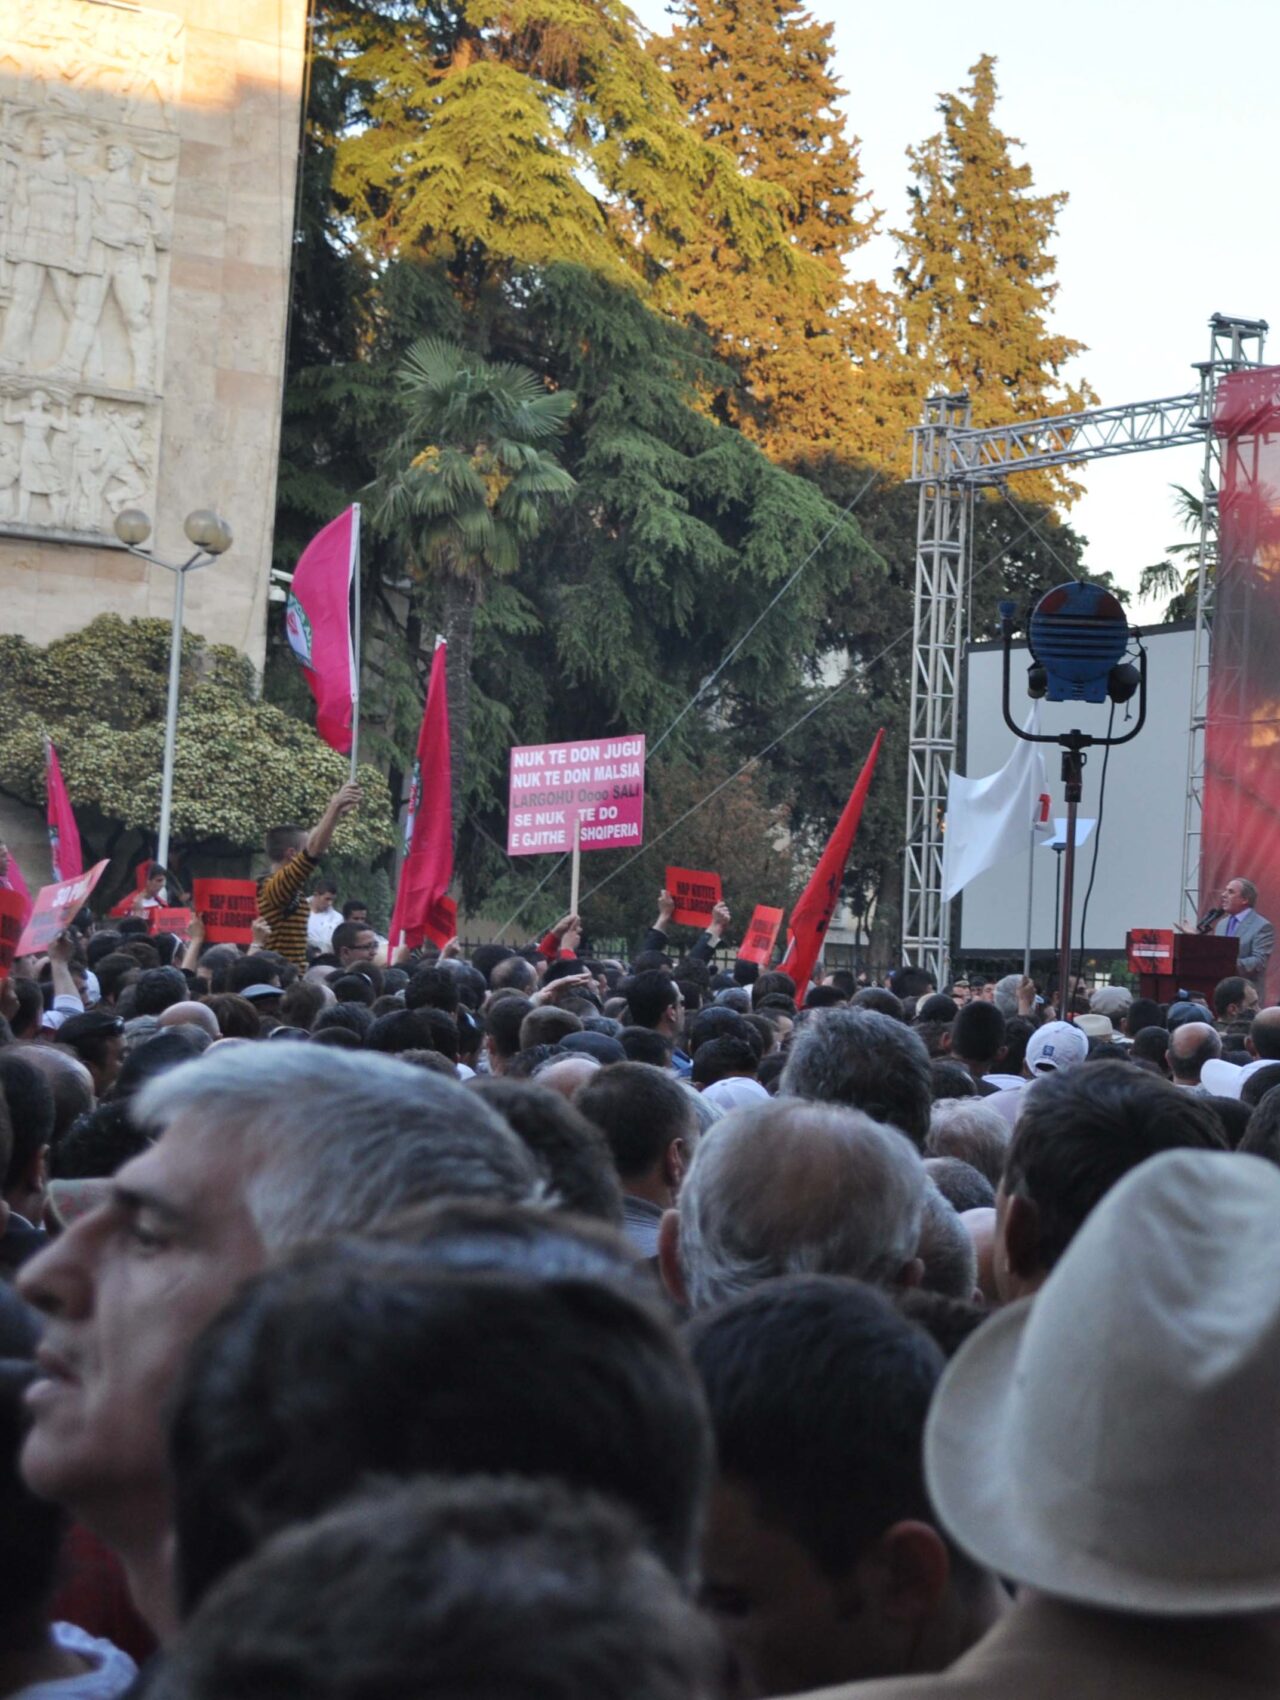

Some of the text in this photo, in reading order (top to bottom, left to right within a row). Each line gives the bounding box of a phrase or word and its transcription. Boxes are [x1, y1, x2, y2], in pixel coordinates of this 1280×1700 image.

[514, 740, 641, 768] NUK TE DON JUGU
[512, 761, 640, 788] NUK TE DON MALSIA
[514, 805, 618, 828] SE NUK TE DO
[511, 833, 520, 848] E
[522, 829, 566, 847] GJITHE
